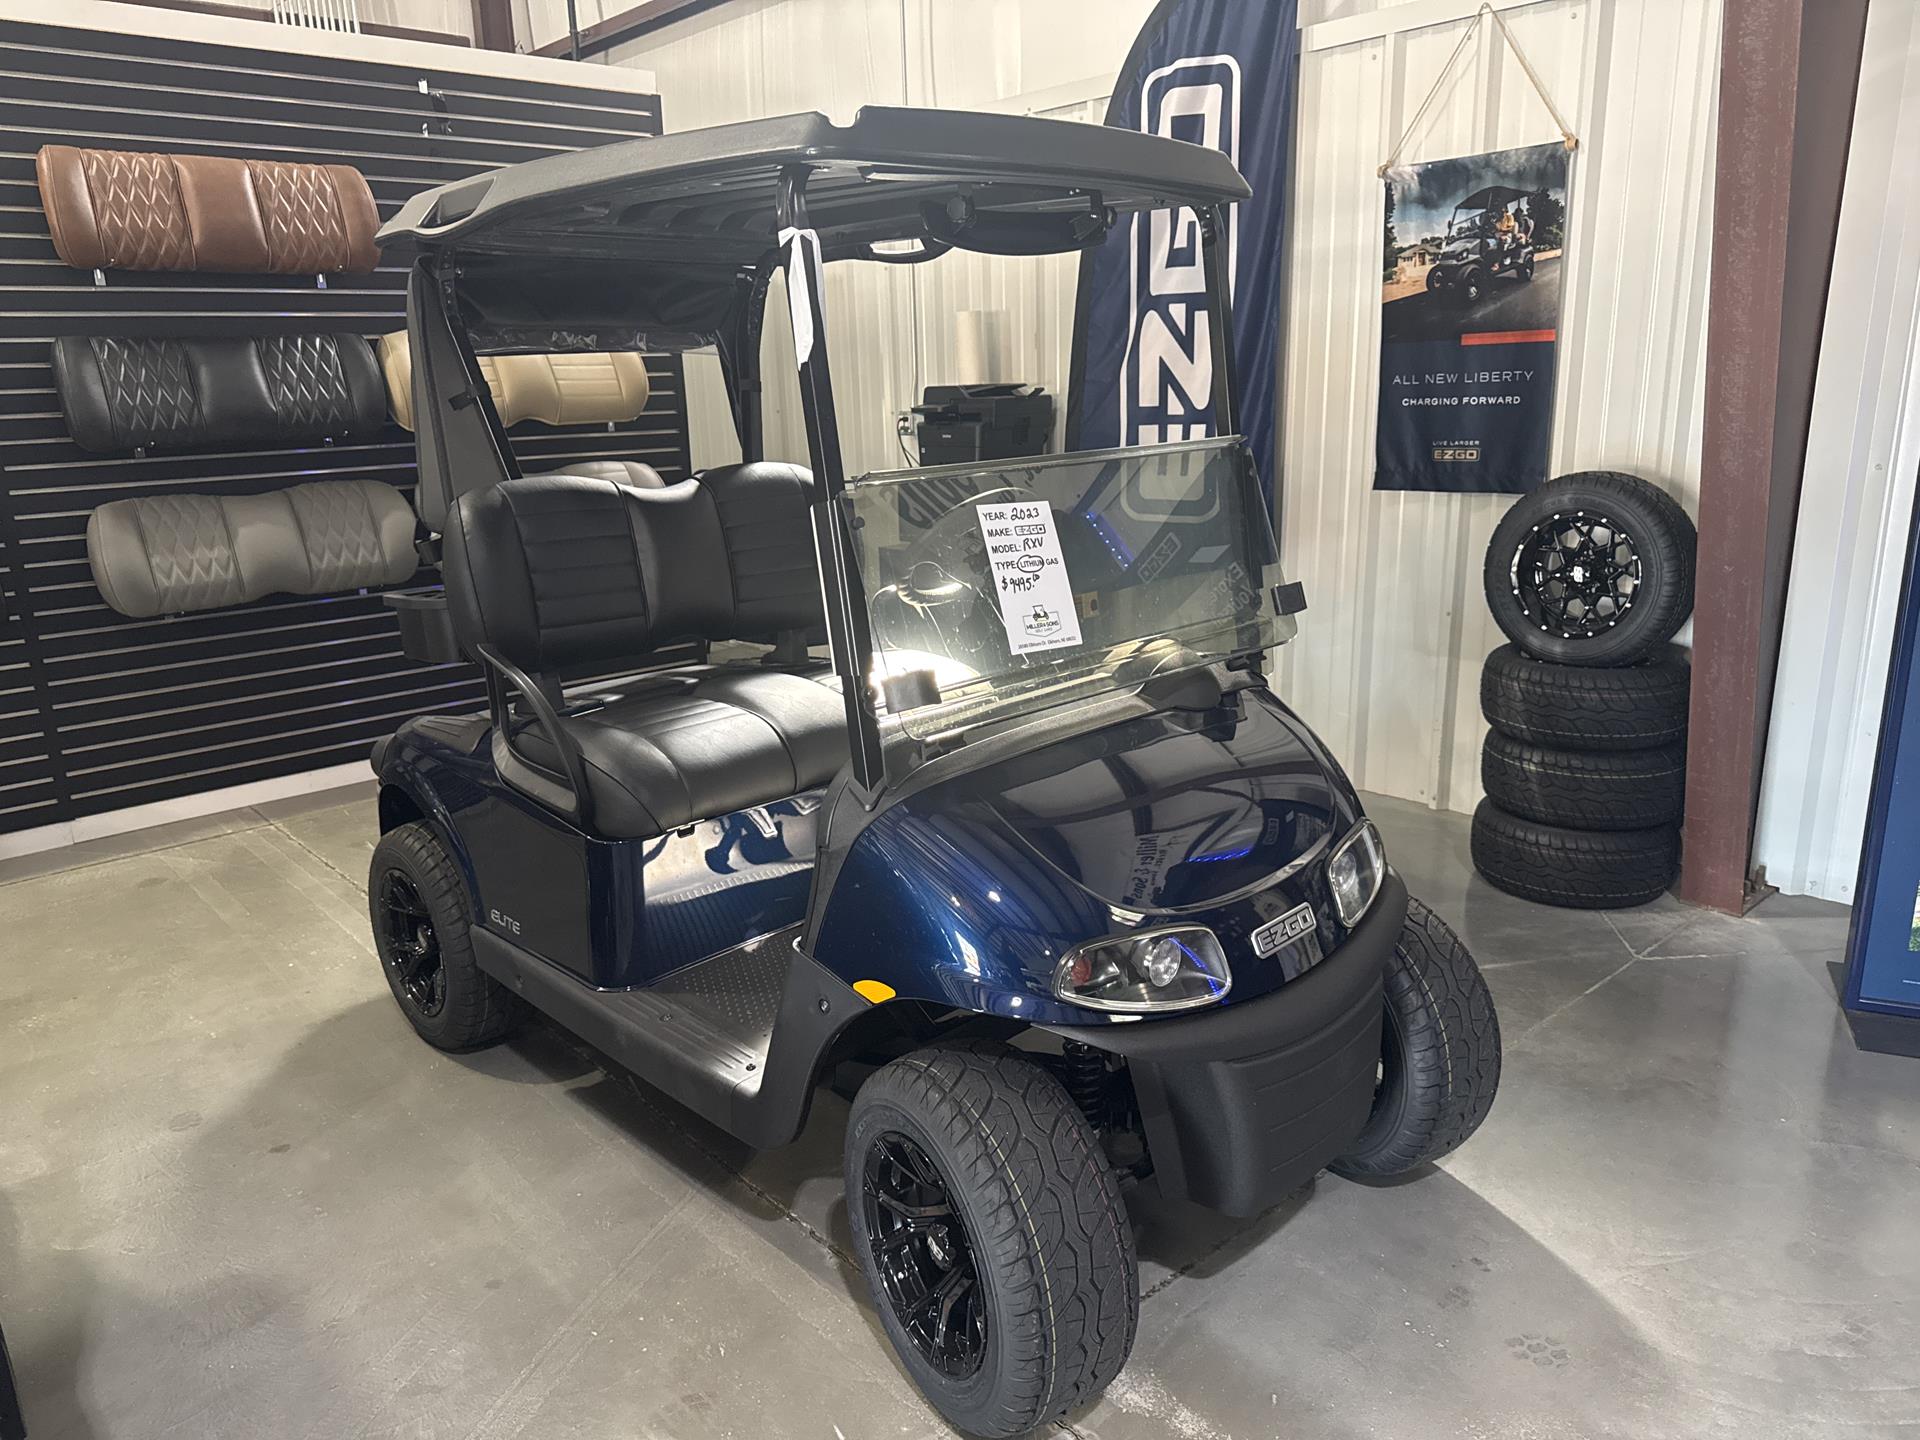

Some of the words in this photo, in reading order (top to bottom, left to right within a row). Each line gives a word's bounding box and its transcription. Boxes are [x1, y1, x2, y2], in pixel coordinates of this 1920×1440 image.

[1392, 374, 1420, 385] ALL
[1424, 373, 1458, 384] NEW
[1464, 370, 1534, 383] LIBERTY
[1401, 396, 1459, 406] CHARGING
[1462, 396, 1521, 405] FORWARD
[982, 511, 1008, 521] YEAR:
[1010, 507, 1040, 521] 2023
[987, 527, 1013, 538] MAKE:
[991, 543, 1021, 554] MODEL:
[1023, 537, 1043, 551] RXV
[1046, 557, 1059, 566] GAS
[491, 909, 521, 935] ELITE
